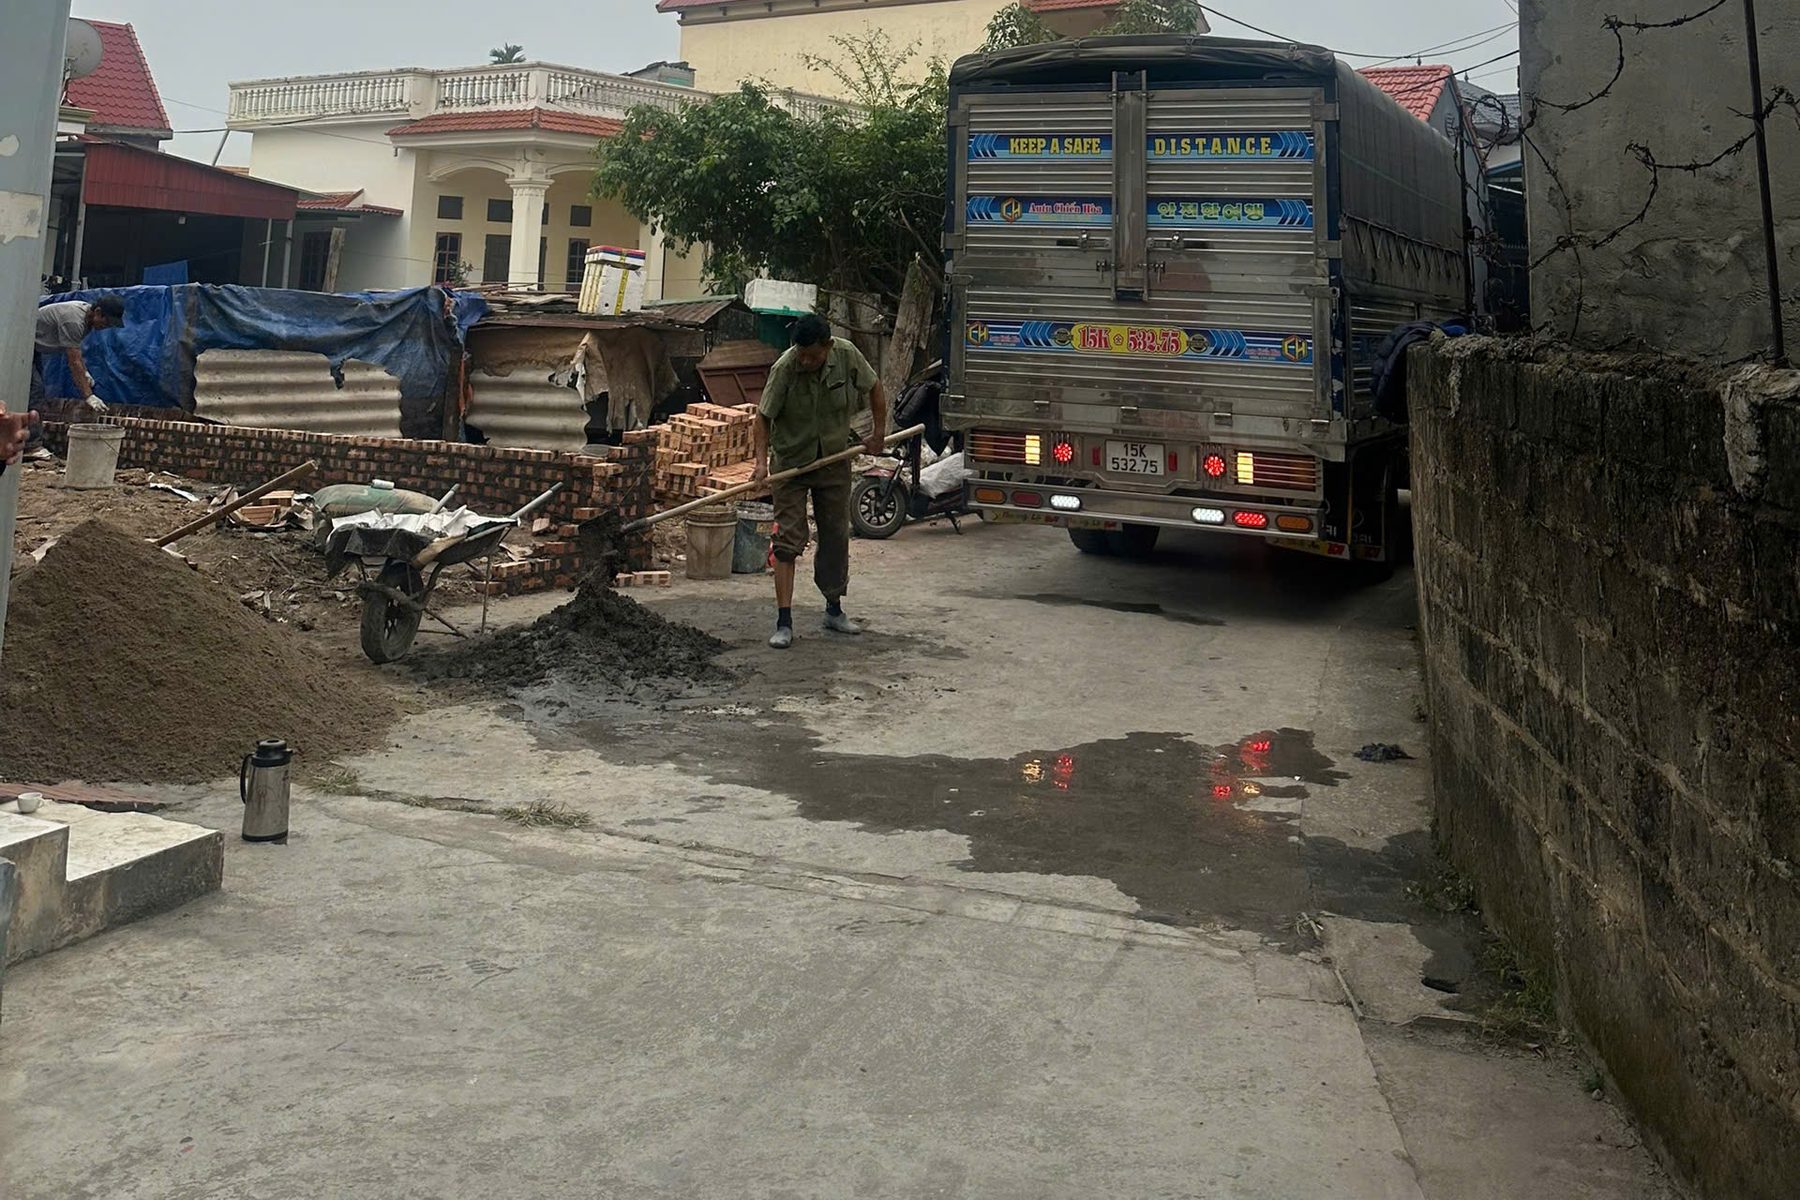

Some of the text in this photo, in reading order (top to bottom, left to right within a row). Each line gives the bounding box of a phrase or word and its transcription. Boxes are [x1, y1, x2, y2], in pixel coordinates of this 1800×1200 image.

[1009, 138, 1101, 154] KEEP A SAFE
[1154, 137, 1273, 155] DISTANCE
[1079, 326, 1182, 354] 15K 532.75
[1124, 443, 1146, 458] 15K
[1111, 457, 1158, 473] 532.75
